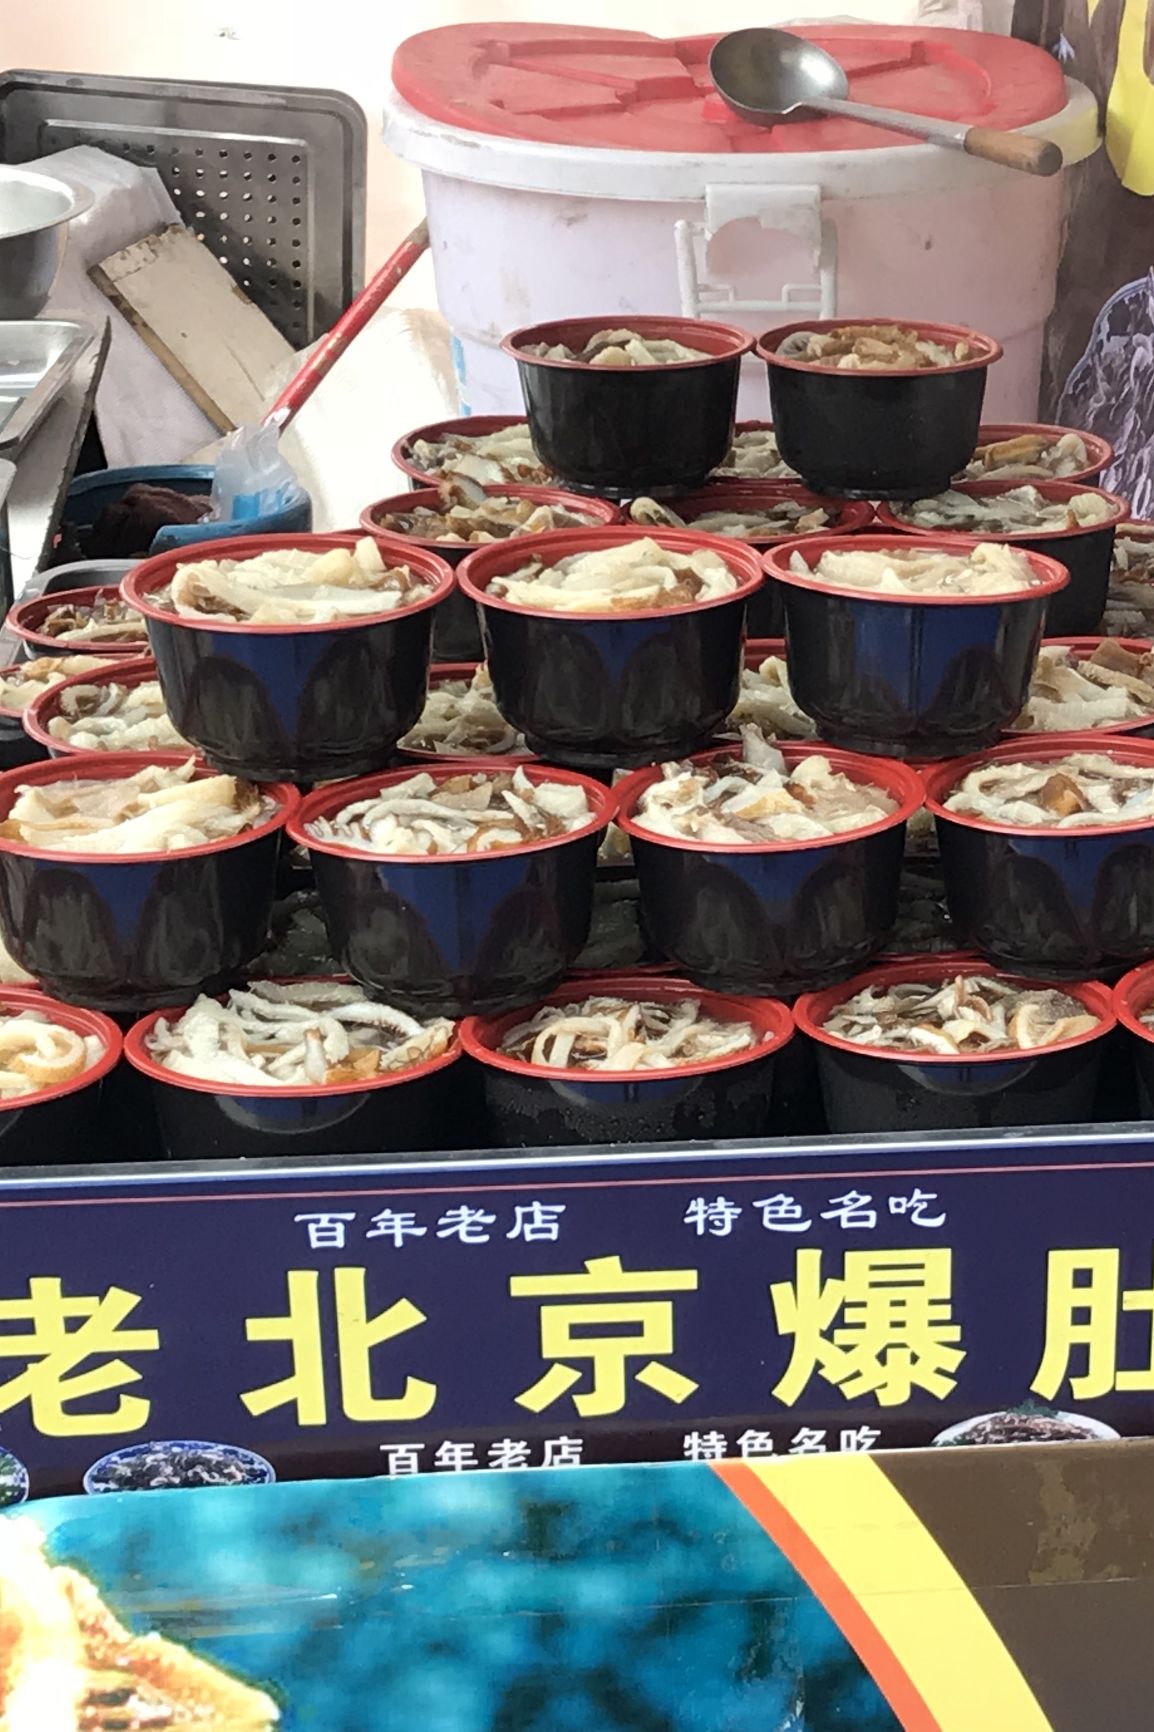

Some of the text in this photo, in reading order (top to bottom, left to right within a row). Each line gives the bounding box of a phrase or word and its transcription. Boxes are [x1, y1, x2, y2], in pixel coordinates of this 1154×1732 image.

[294, 1188, 945, 1249] 百年老店 特色名吃
[380, 1425, 881, 1474] 百年老店 特色名吃
